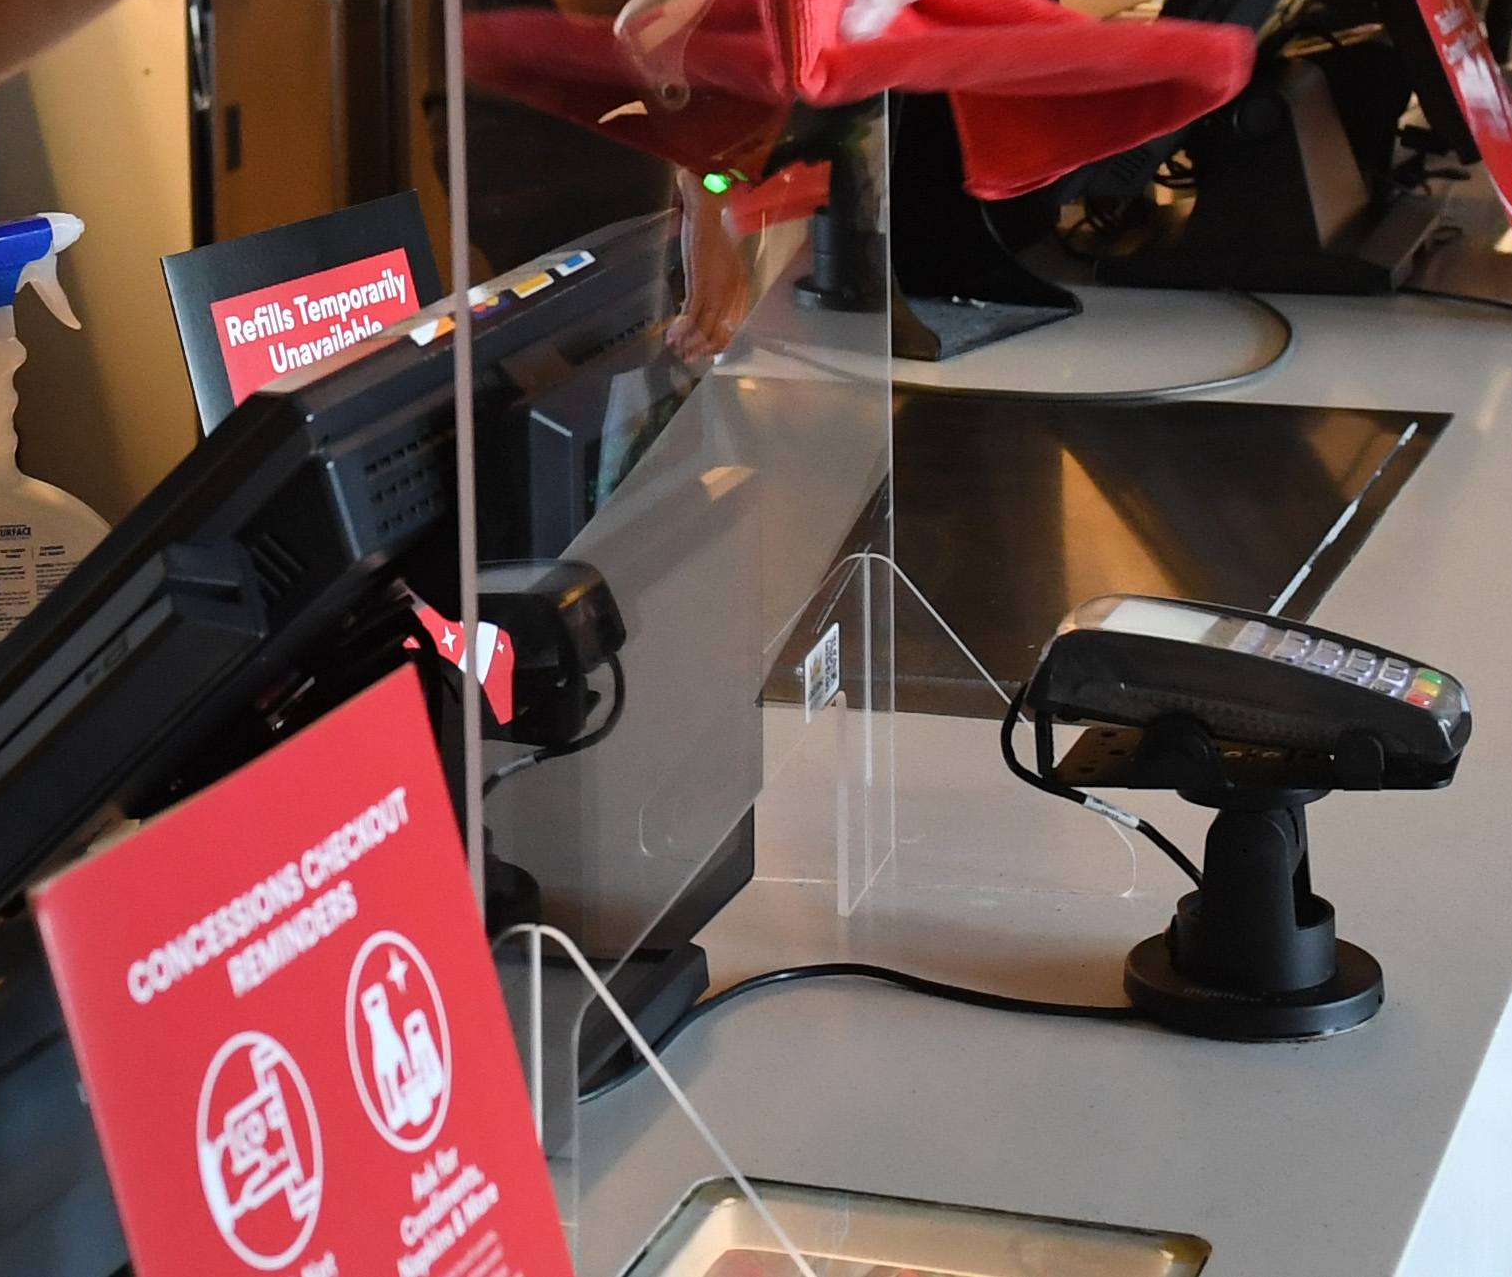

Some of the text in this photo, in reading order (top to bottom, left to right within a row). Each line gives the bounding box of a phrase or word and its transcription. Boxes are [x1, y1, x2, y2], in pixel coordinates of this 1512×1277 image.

[225, 269, 406, 347] Refills Temporarily
[268, 315, 383, 373] Unavailable
[127, 786, 409, 1004] CONCESSIONS CHECKOUT
[227, 879, 358, 999] REMINDERS
